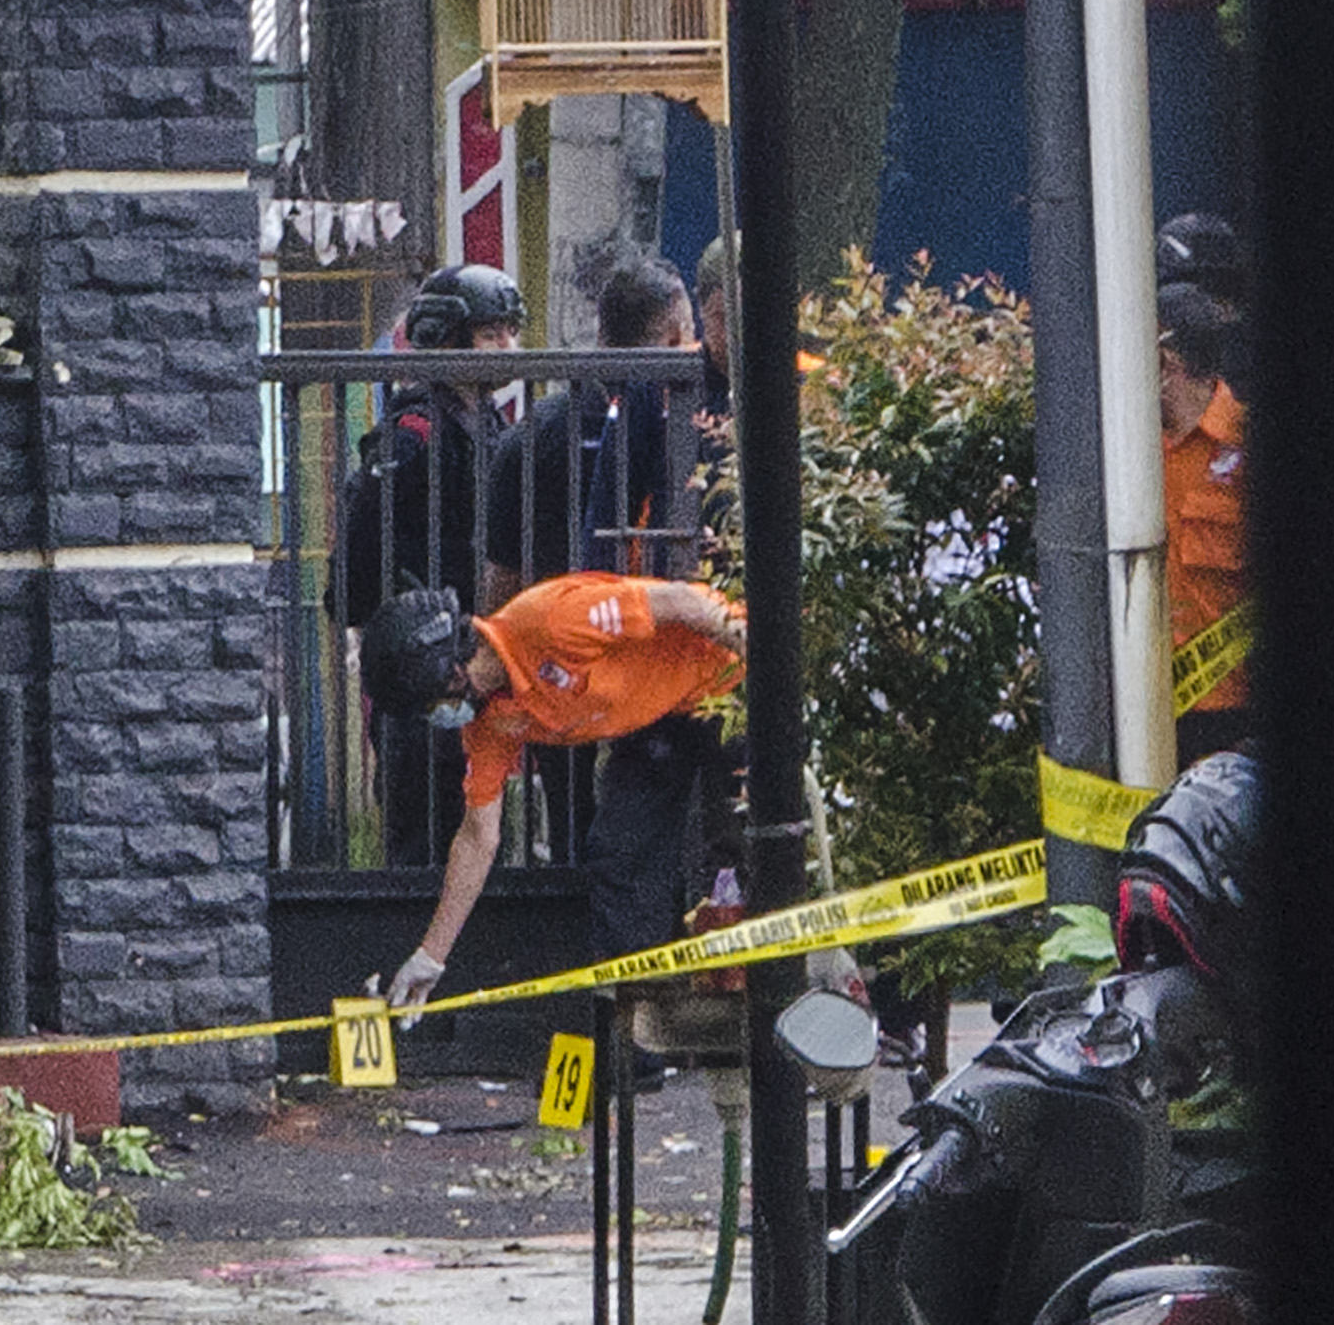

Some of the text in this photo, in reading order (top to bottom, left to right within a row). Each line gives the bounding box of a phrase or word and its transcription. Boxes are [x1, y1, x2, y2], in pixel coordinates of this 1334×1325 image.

[901, 866, 976, 906] DILARANG
[593, 951, 670, 981] DILARANG
[798, 903, 848, 933] POLISI
[350, 1018, 382, 1069] 20
[554, 1051, 582, 1112] 19
